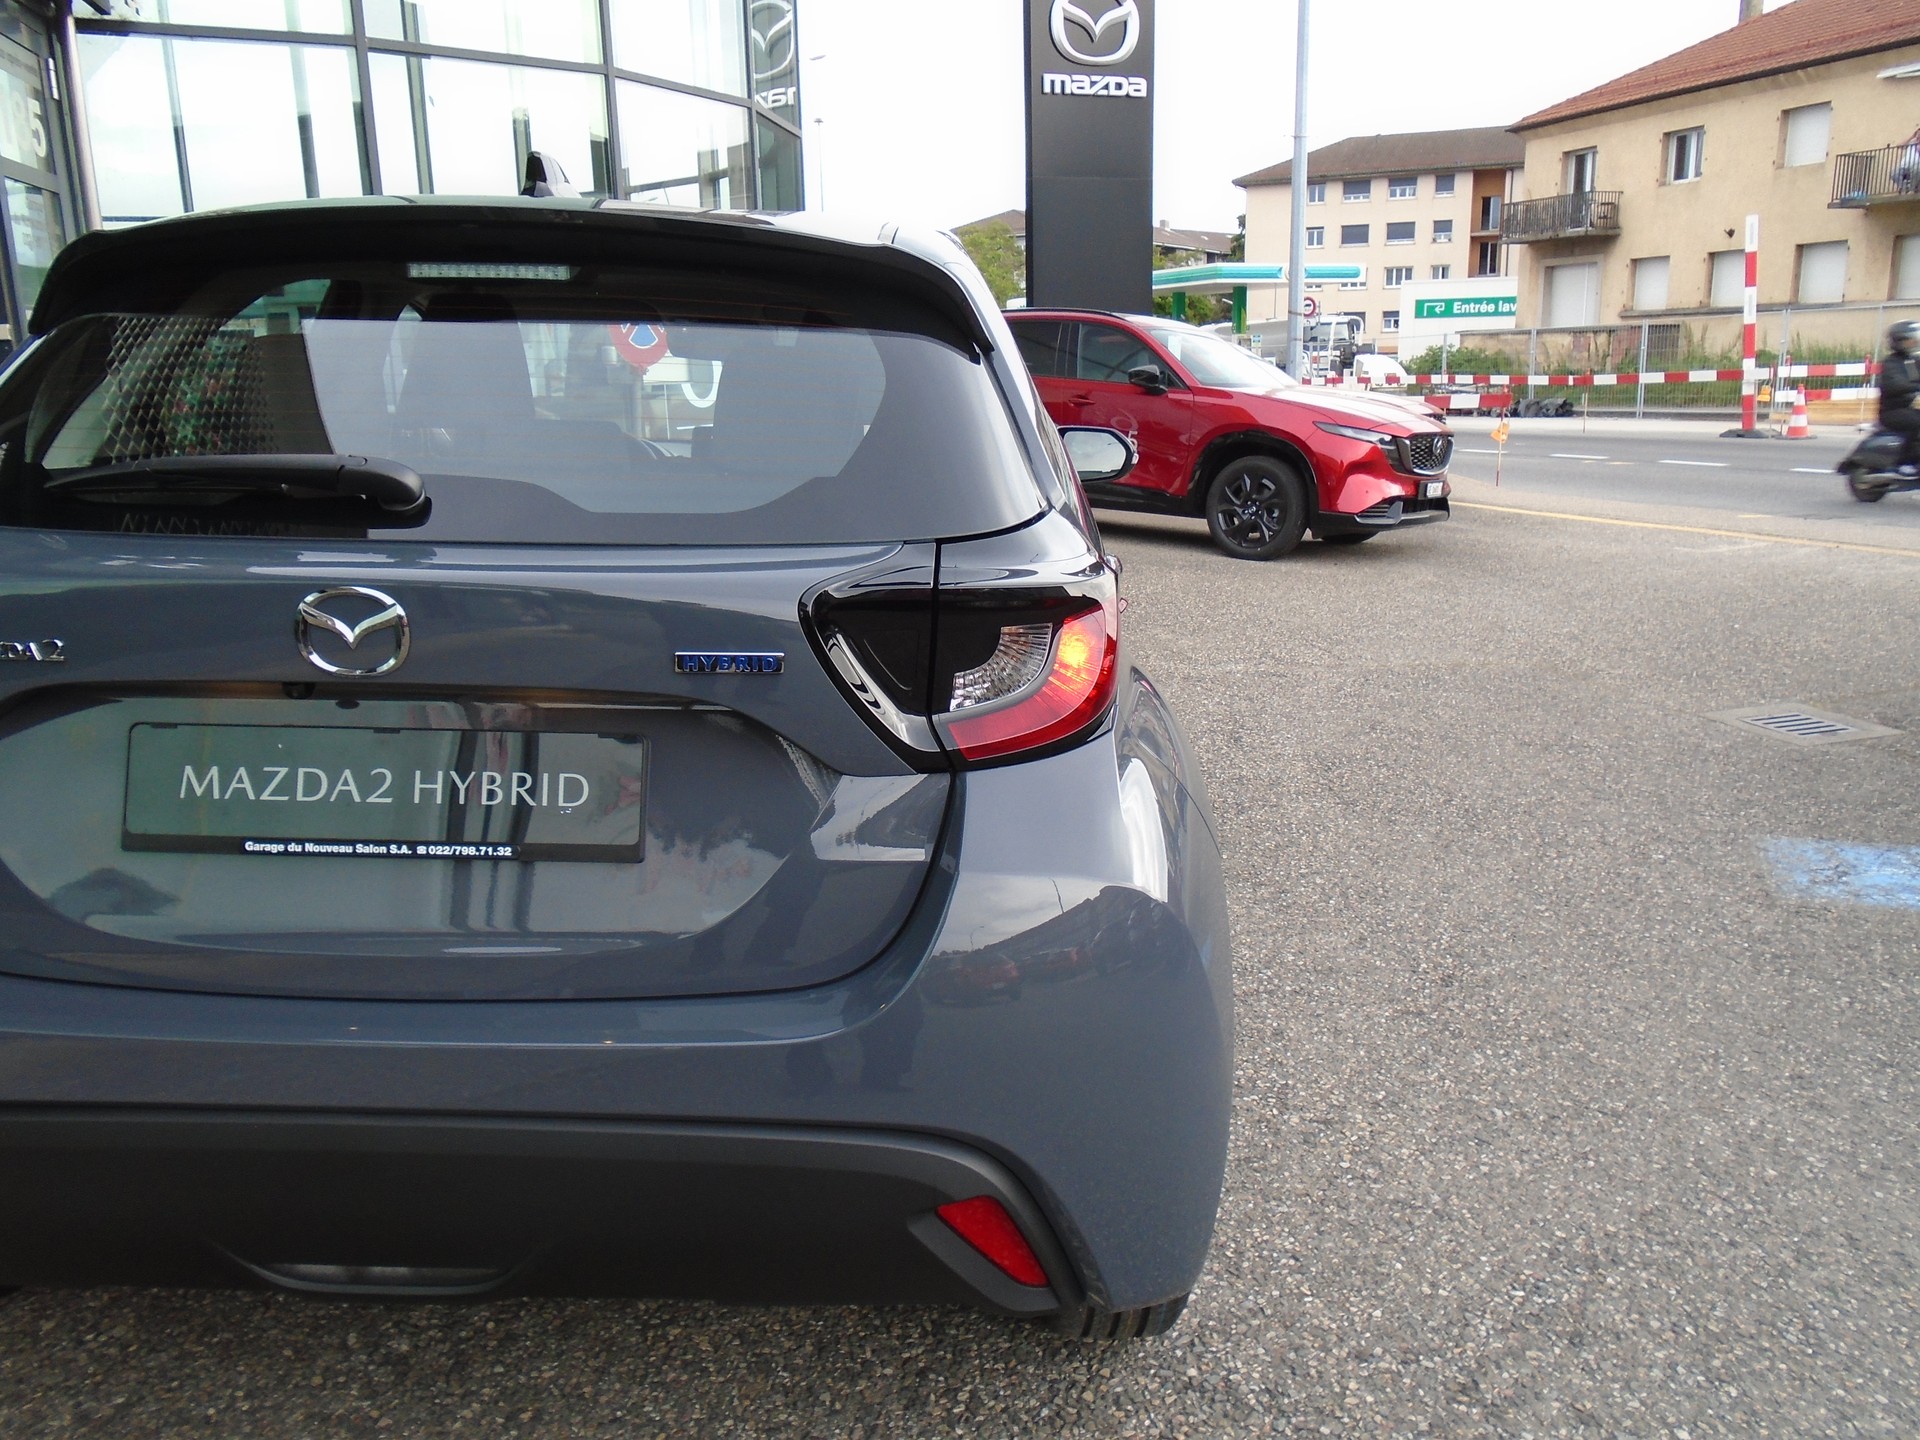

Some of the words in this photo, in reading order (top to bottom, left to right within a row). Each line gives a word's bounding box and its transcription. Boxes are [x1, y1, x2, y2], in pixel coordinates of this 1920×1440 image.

[1453, 301, 1495, 314] Entrée
[0, 639, 65, 661] DA2
[683, 655, 778, 672] HYBRID
[179, 765, 393, 803] MAZDA2
[413, 770, 590, 807] HYBRID
[244, 841, 285, 854] Garage
[287, 843, 302, 852] du
[304, 842, 353, 853] Nouveau
[355, 843, 387, 854] Salon
[389, 844, 412, 854] S.A.
